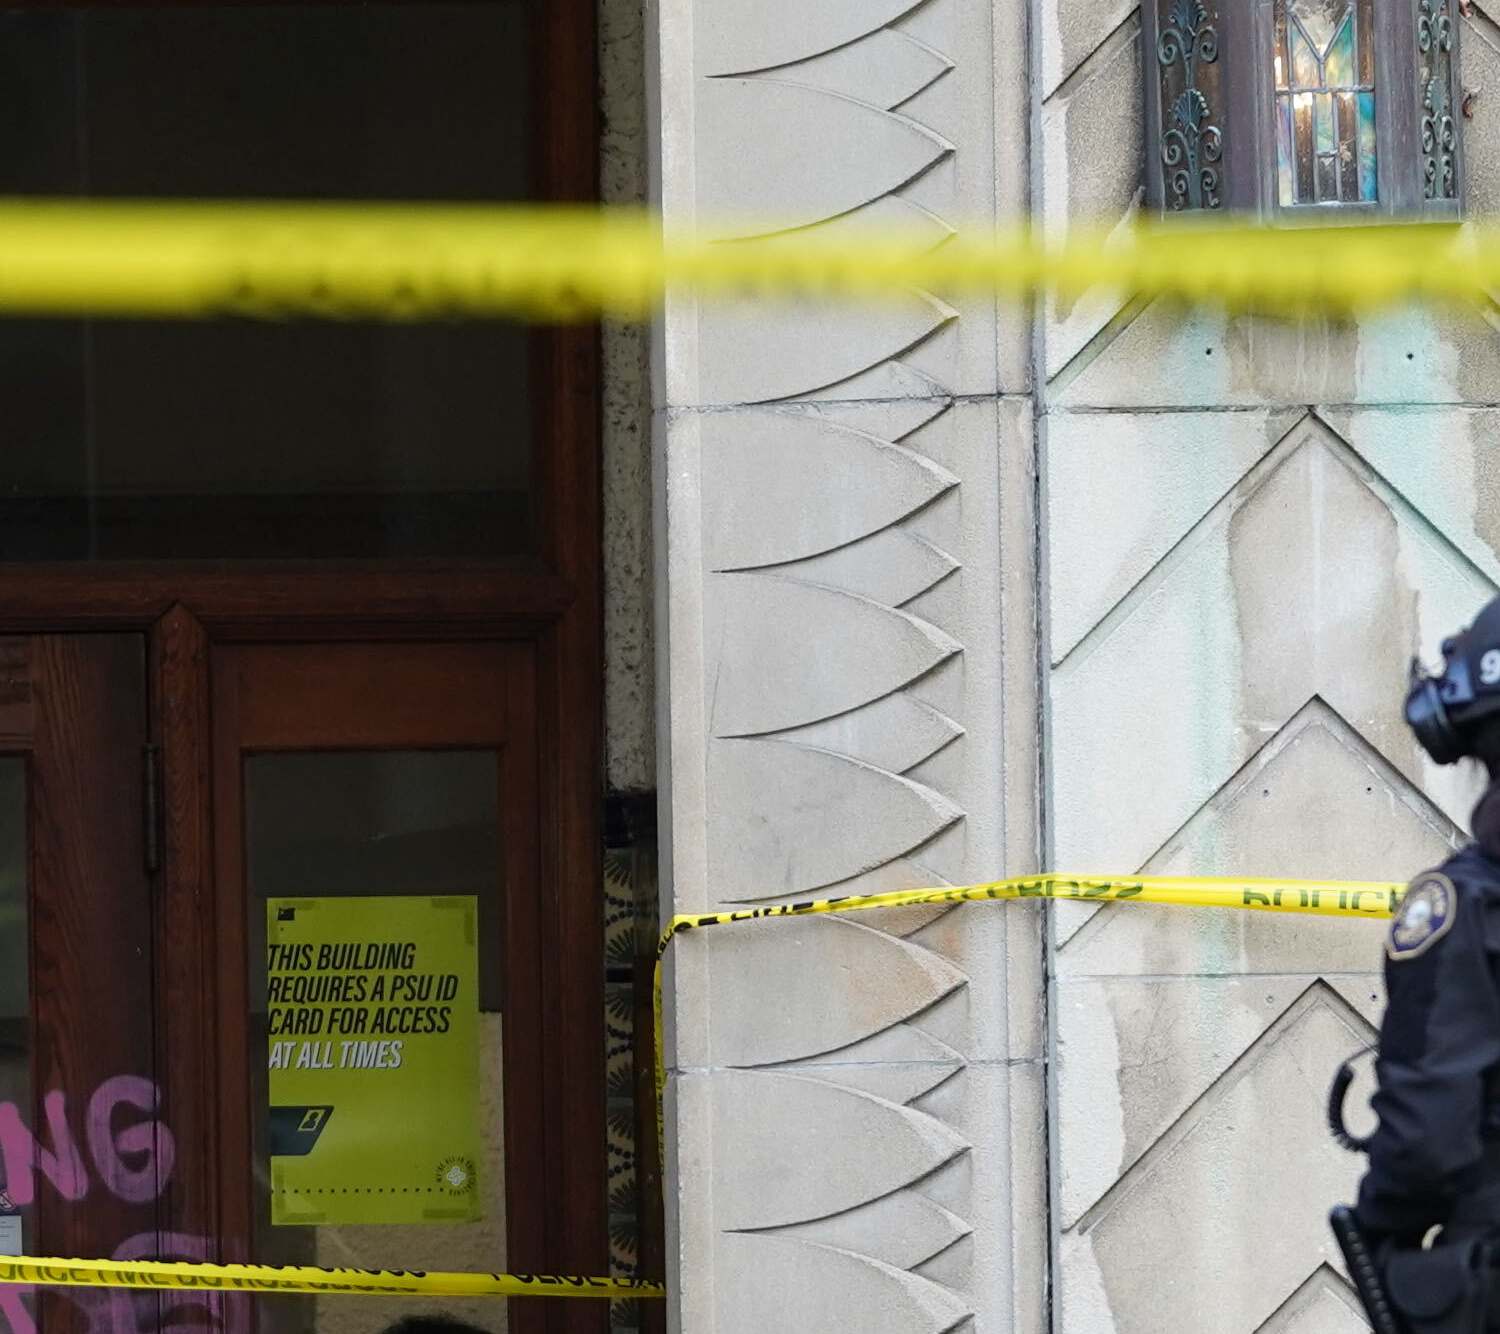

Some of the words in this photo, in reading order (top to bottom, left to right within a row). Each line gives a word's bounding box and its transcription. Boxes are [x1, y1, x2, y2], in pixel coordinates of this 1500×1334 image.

[267, 944, 314, 971] THIS
[316, 942, 417, 970] BUILDING
[267, 975, 368, 1004] REQUIRES
[369, 975, 385, 1002] A
[389, 974, 434, 1002] PSU
[435, 974, 459, 1001] ID
[267, 1008, 324, 1035] CARD
[326, 1008, 369, 1034] FOR
[371, 1007, 452, 1034] ACCESS
[269, 1041, 297, 1071] AT
[296, 1041, 334, 1070] ALL
[335, 1040, 405, 1070] TIMES
